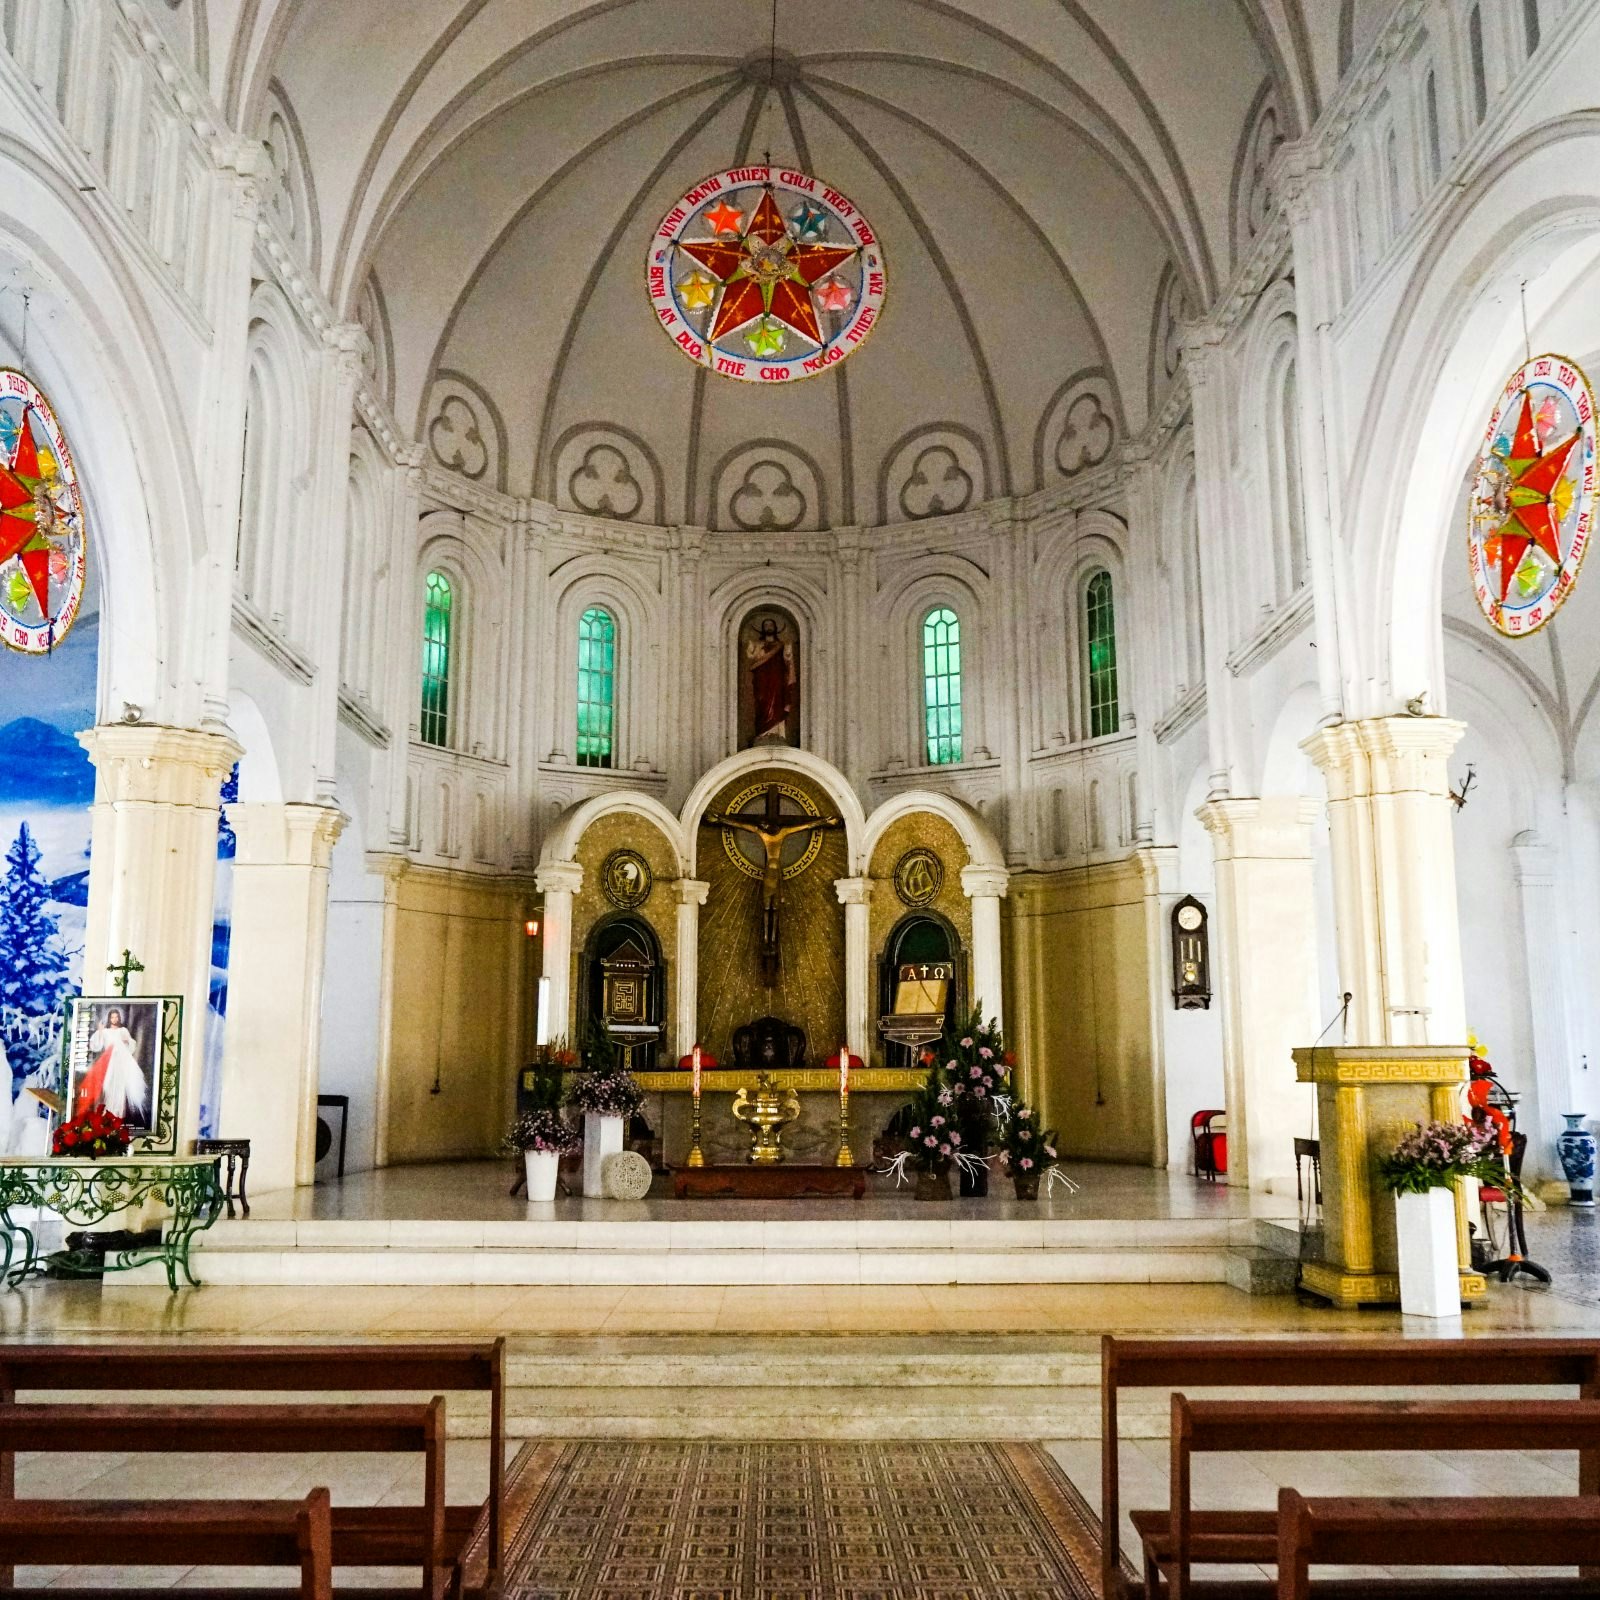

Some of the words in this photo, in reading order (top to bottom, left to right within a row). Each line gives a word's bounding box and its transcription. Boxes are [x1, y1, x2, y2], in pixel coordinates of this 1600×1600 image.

[659, 207, 686, 238] VINH
[685, 178, 722, 206] DANH
[727, 168, 770, 184] THIEN
[780, 171, 816, 192] CHUA
[822, 188, 855, 218] TREN
[852, 218, 875, 246] TROI
[650, 266, 666, 298] BINH
[658, 307, 678, 325] AN
[717, 357, 746, 376] THE
[760, 367, 790, 380] CHO
[846, 306, 877, 343] THIEN
[869, 272, 883, 296] TAM
[1570, 512, 1589, 560] THIEN
[1584, 465, 1593, 494] TAM
[15, 628, 29, 645] CHO
[907, 968, 917, 980] A
[934, 967, 945, 979] Ω
